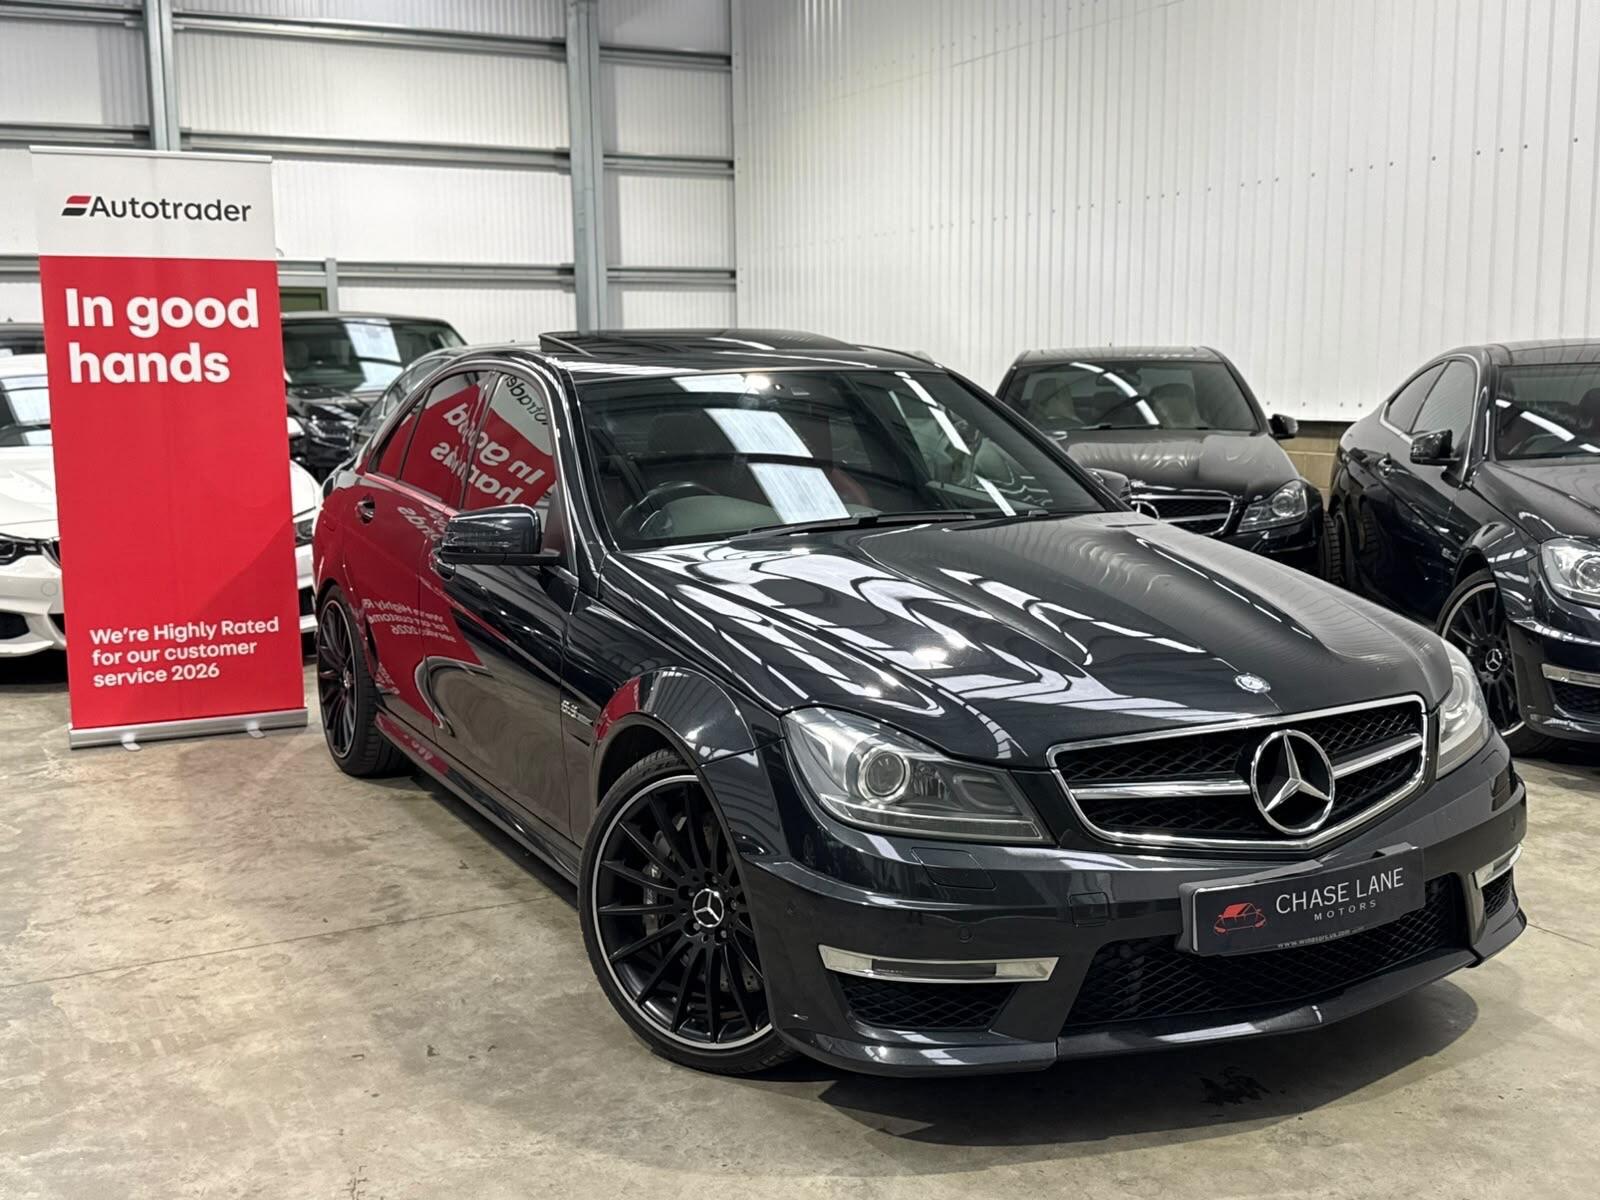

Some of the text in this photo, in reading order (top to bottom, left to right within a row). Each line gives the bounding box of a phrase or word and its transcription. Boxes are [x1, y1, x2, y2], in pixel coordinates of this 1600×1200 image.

[89, 195, 252, 222] Autotrader
[65, 288, 259, 338] In good
[68, 342, 231, 384] hands
[89, 616, 279, 646] We're Highly Rated
[92, 640, 258, 666] for our customer
[93, 662, 220, 688] service 2026
[1275, 867, 1405, 915] CHASE LANE
[1313, 899, 1377, 922] MOTORS
